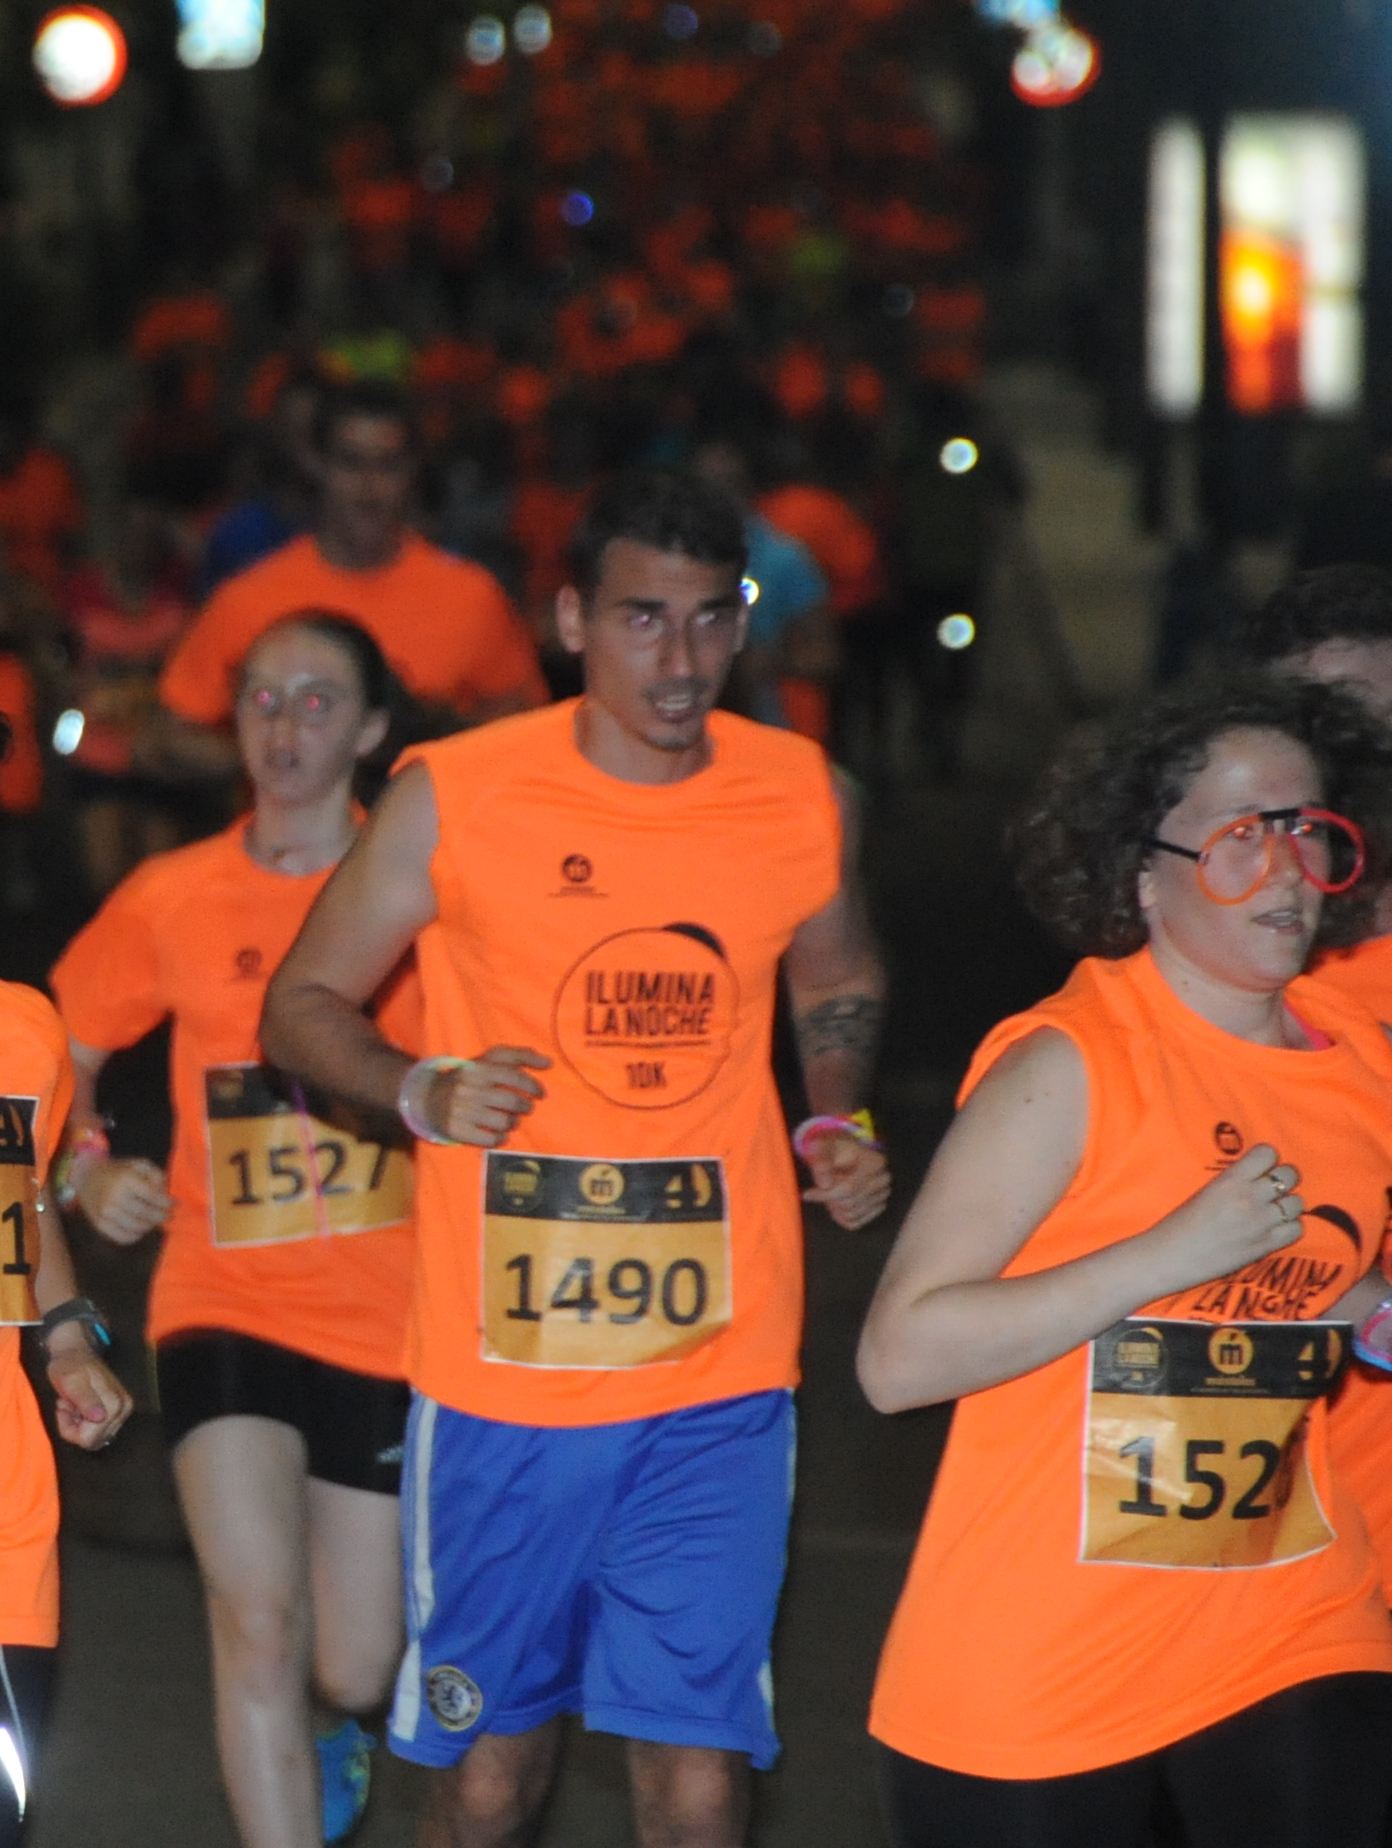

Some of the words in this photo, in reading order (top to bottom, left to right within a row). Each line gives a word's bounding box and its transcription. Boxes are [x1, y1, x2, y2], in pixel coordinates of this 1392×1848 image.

[585, 970, 715, 1004] ILUMINA
[505, 1253, 707, 1327] 1490
[1118, 1435, 1295, 1521] 152
